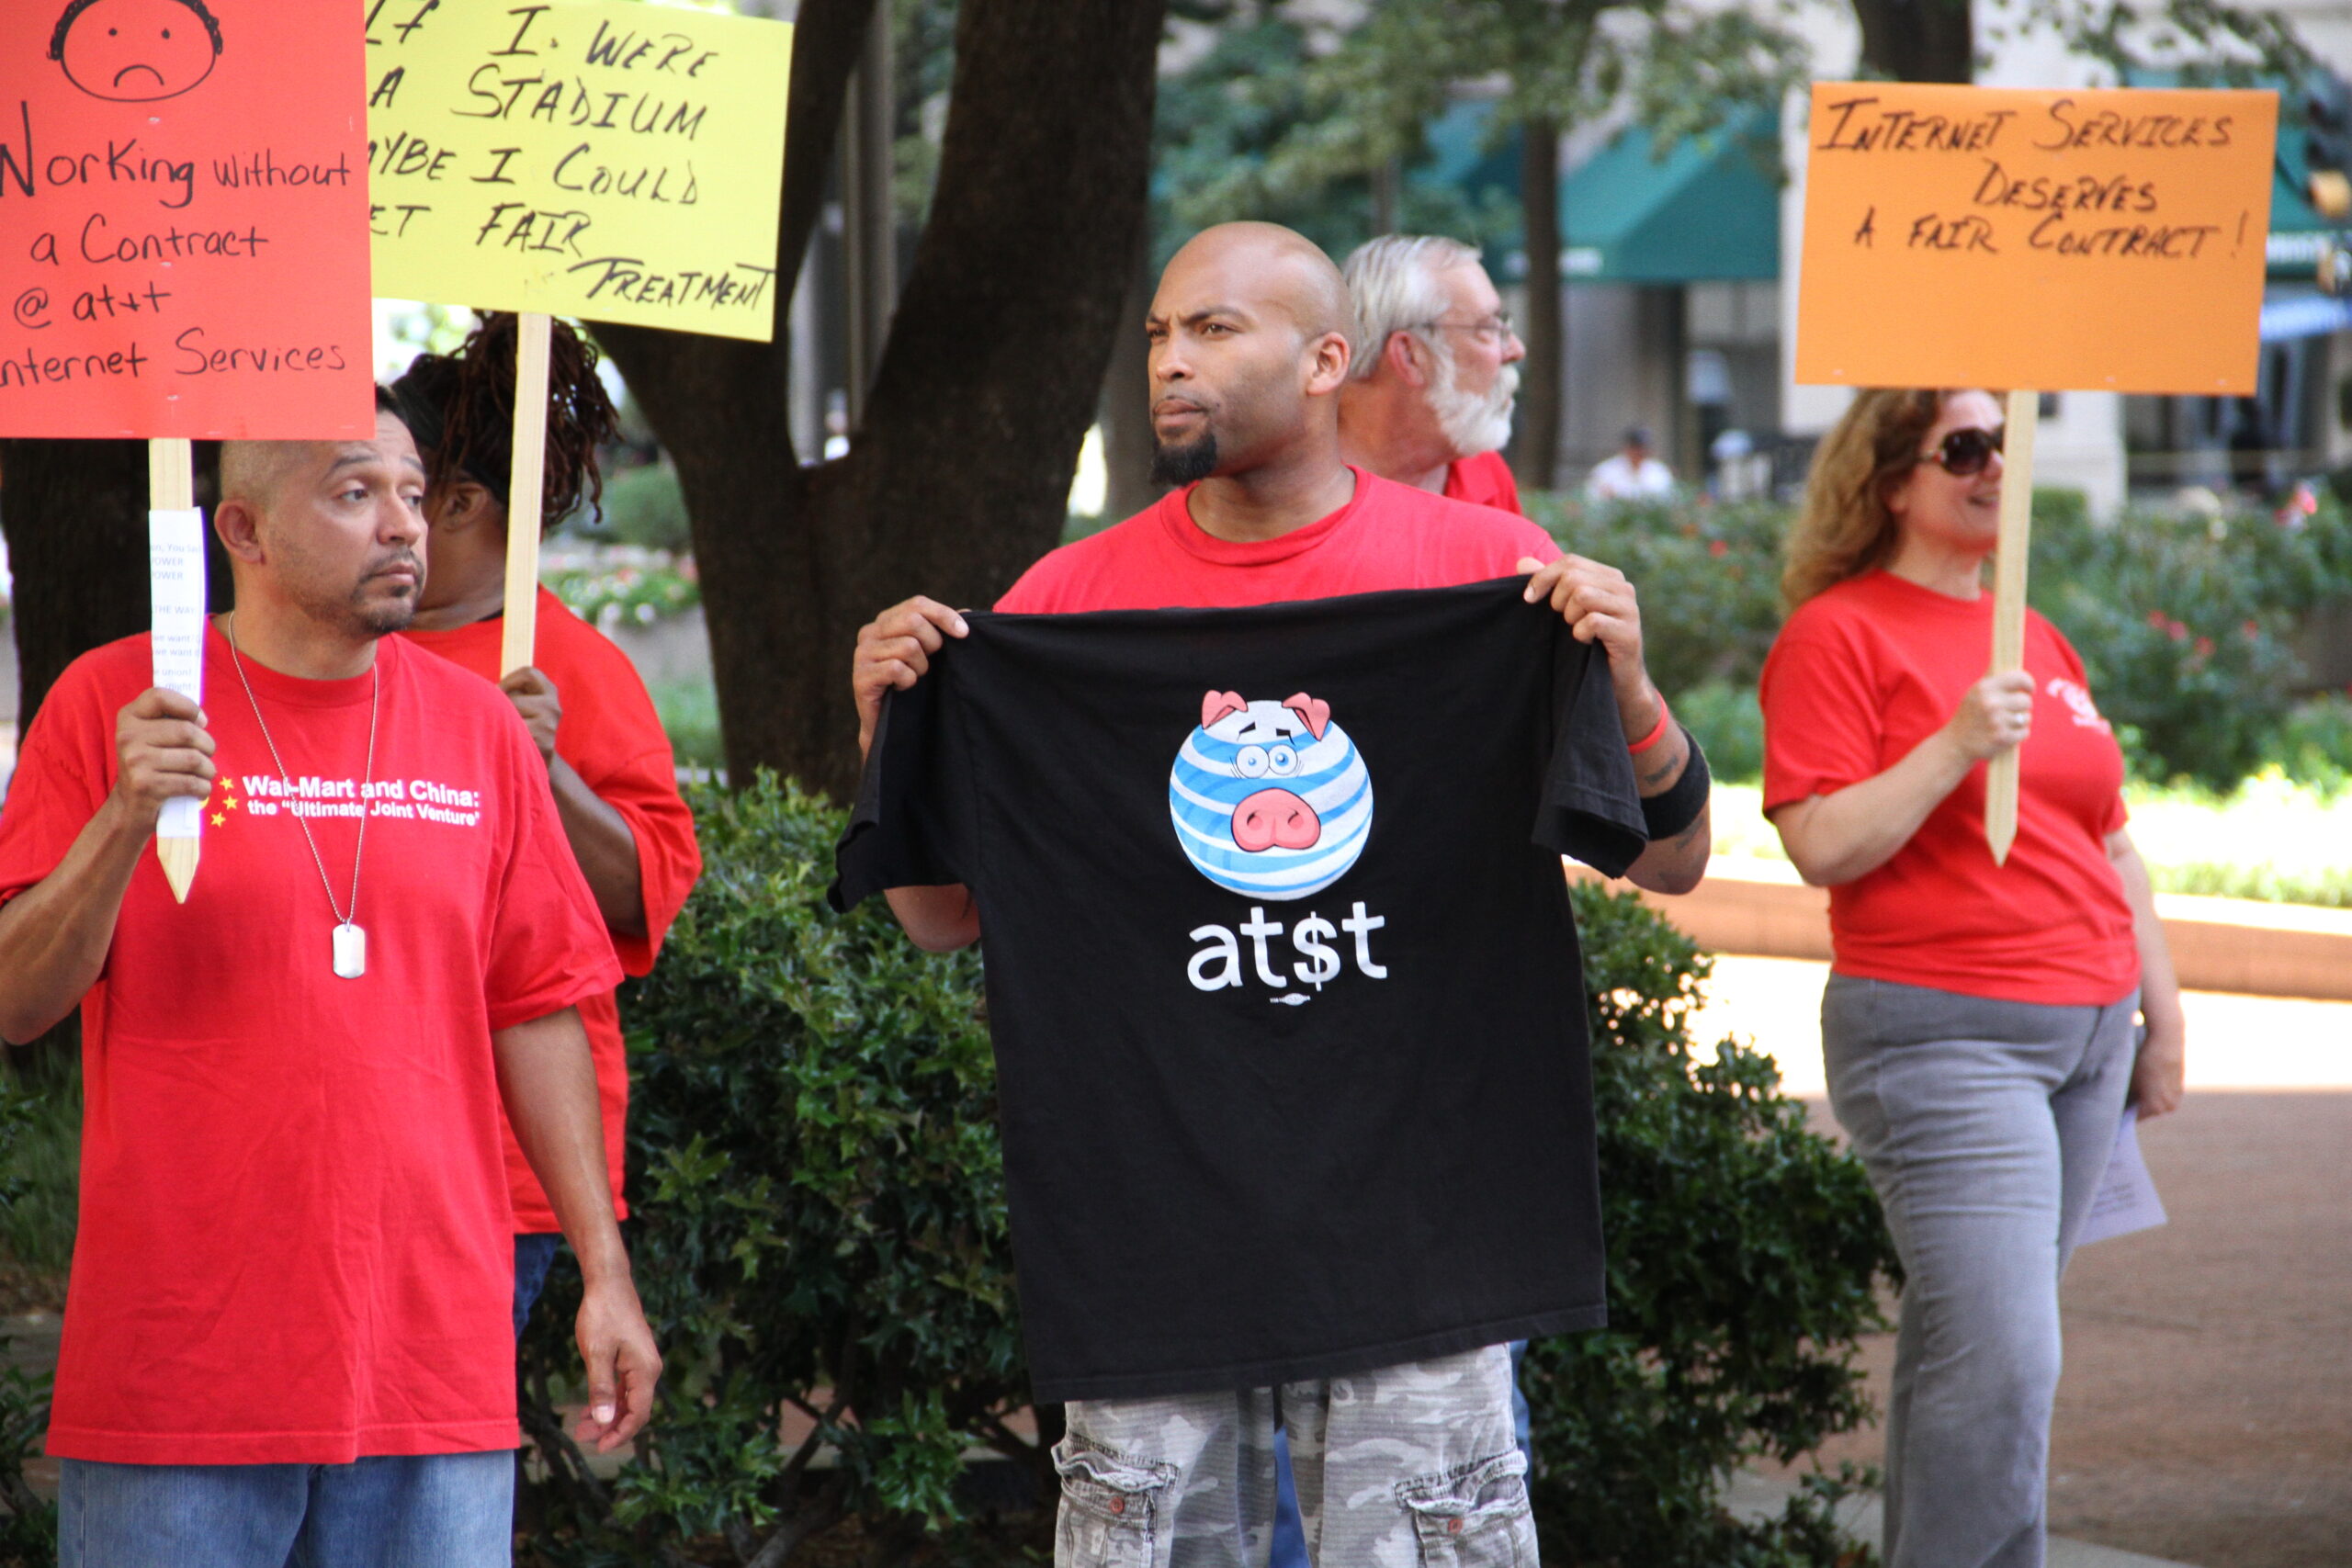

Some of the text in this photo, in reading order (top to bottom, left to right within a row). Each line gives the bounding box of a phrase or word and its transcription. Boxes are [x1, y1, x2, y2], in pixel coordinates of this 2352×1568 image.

[586, 20, 718, 77] WERE
[369, 63, 707, 141] A STADIUM
[1818, 97, 2232, 152] INTERNET SERVICES
[471, 148, 522, 185] I
[1973, 163, 2156, 213] DESERVES
[30, 213, 268, 265] a Contract
[476, 203, 591, 257] FAIR
[1855, 208, 1874, 246] A
[1909, 215, 1996, 253] FAIR
[14, 288, 52, 329] @
[565, 256, 776, 312] TREATMENT
[0, 343, 148, 388] nternet
[243, 774, 481, 807] Wal-Mart and China:
[247, 799, 277, 816] the
[369, 800, 413, 819] Joint
